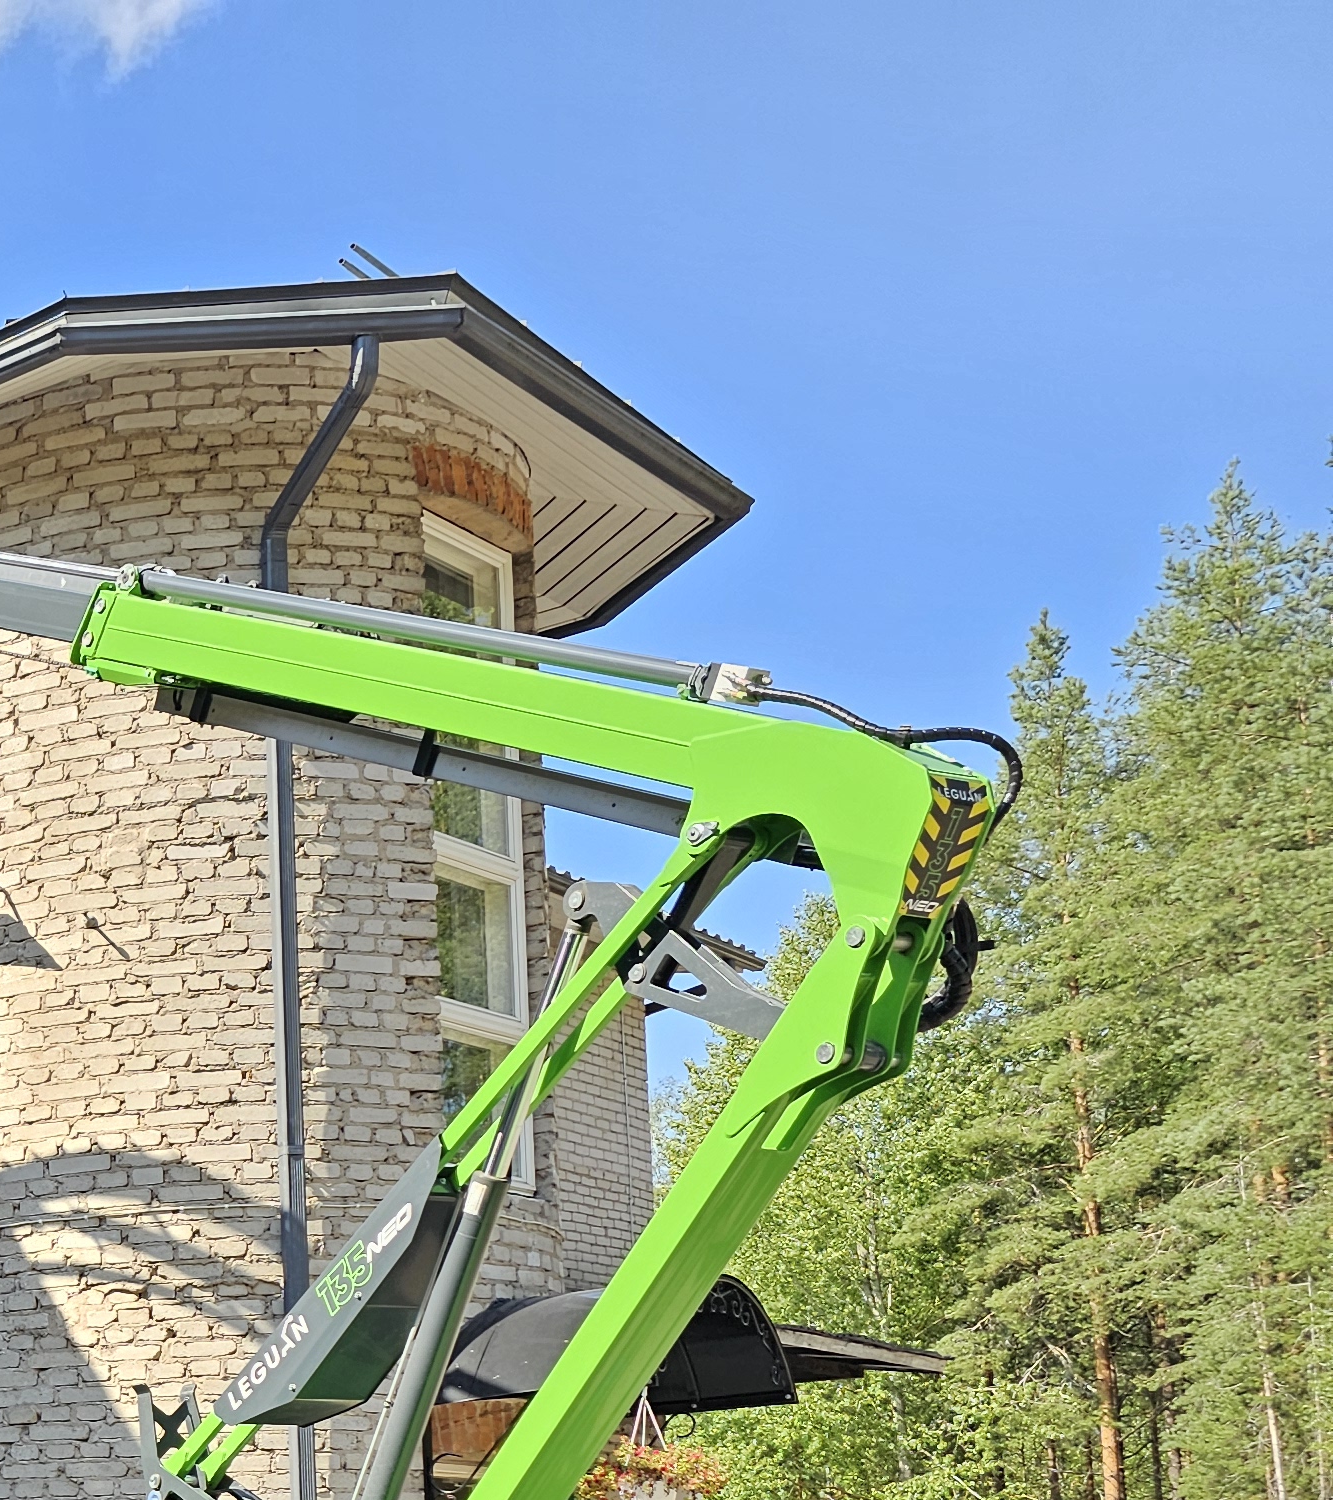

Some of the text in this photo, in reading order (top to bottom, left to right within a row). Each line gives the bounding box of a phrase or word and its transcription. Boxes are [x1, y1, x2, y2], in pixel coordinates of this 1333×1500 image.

[937, 786, 982, 803] LEGUAN
[916, 808, 964, 900] 135
[904, 899, 939, 913] NEO
[227, 1202, 413, 1411] LEGUAN 135 NEO
